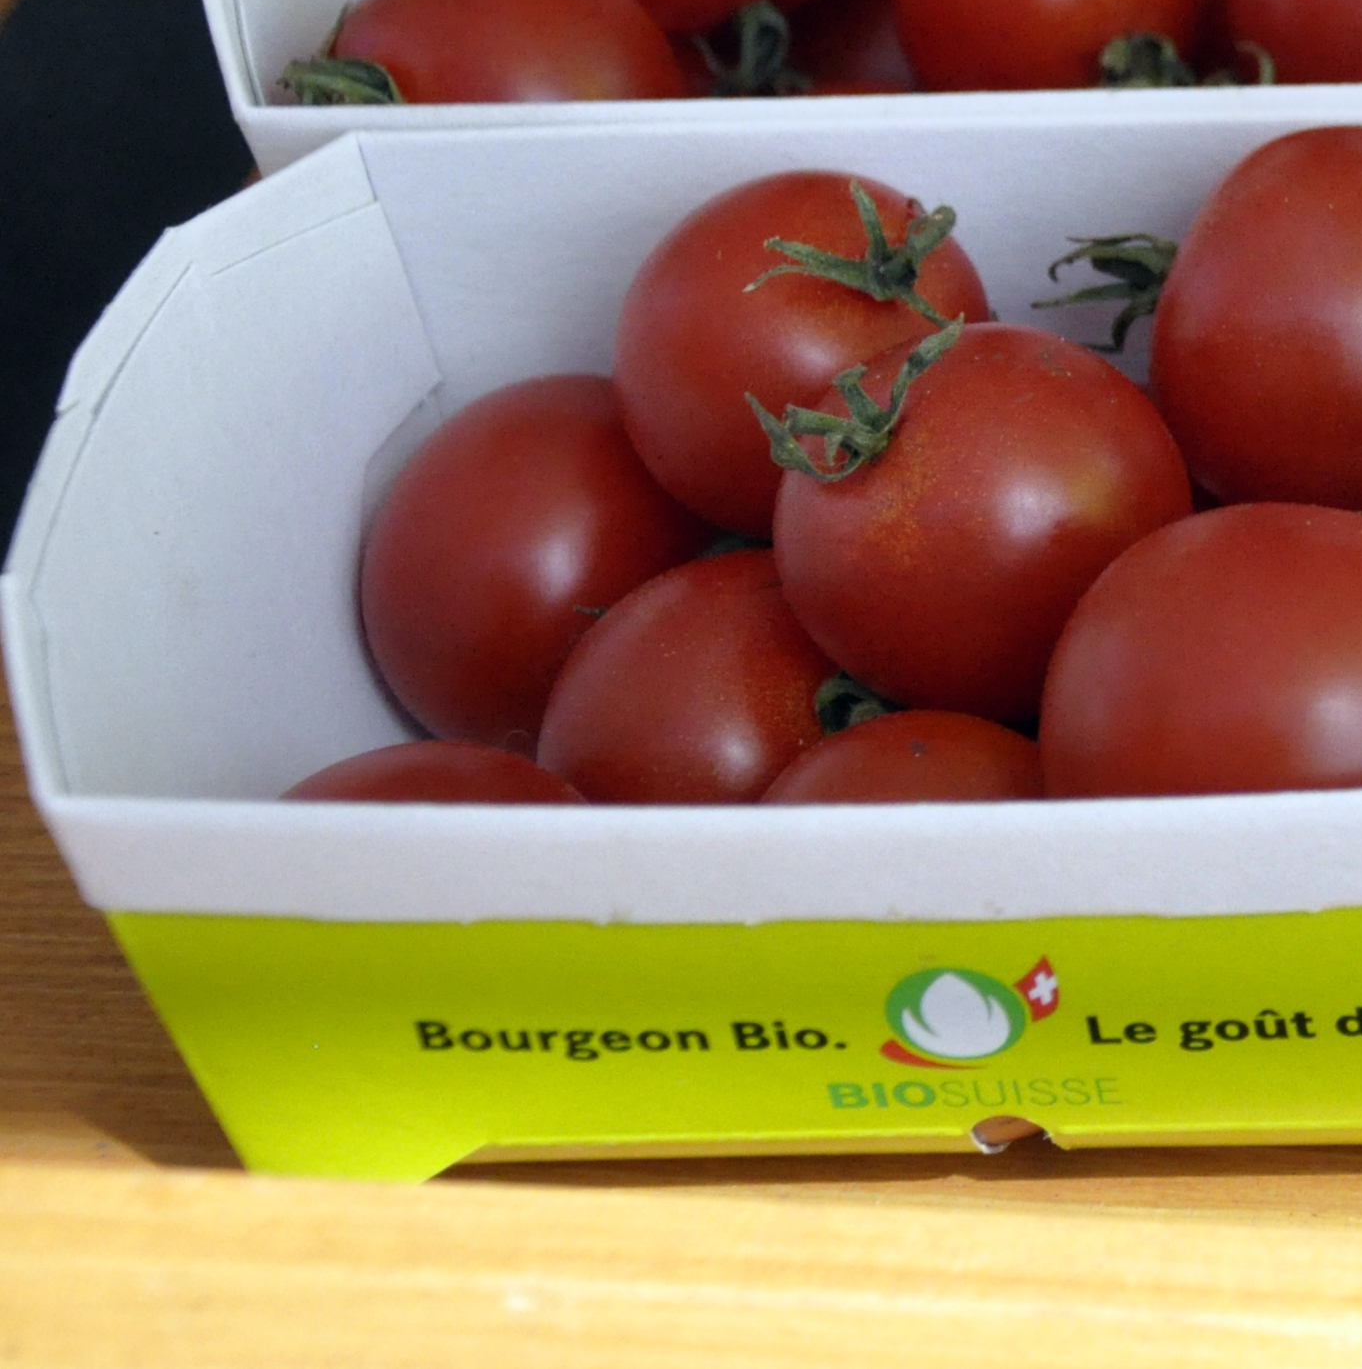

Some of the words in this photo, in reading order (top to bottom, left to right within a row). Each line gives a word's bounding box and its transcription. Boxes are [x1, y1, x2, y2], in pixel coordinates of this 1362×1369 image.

[411, 1019, 711, 1061] Bourgeon
[729, 1019, 848, 1053] Bio.
[1085, 1014, 1158, 1046] Le
[1178, 1008, 1317, 1052] goût
